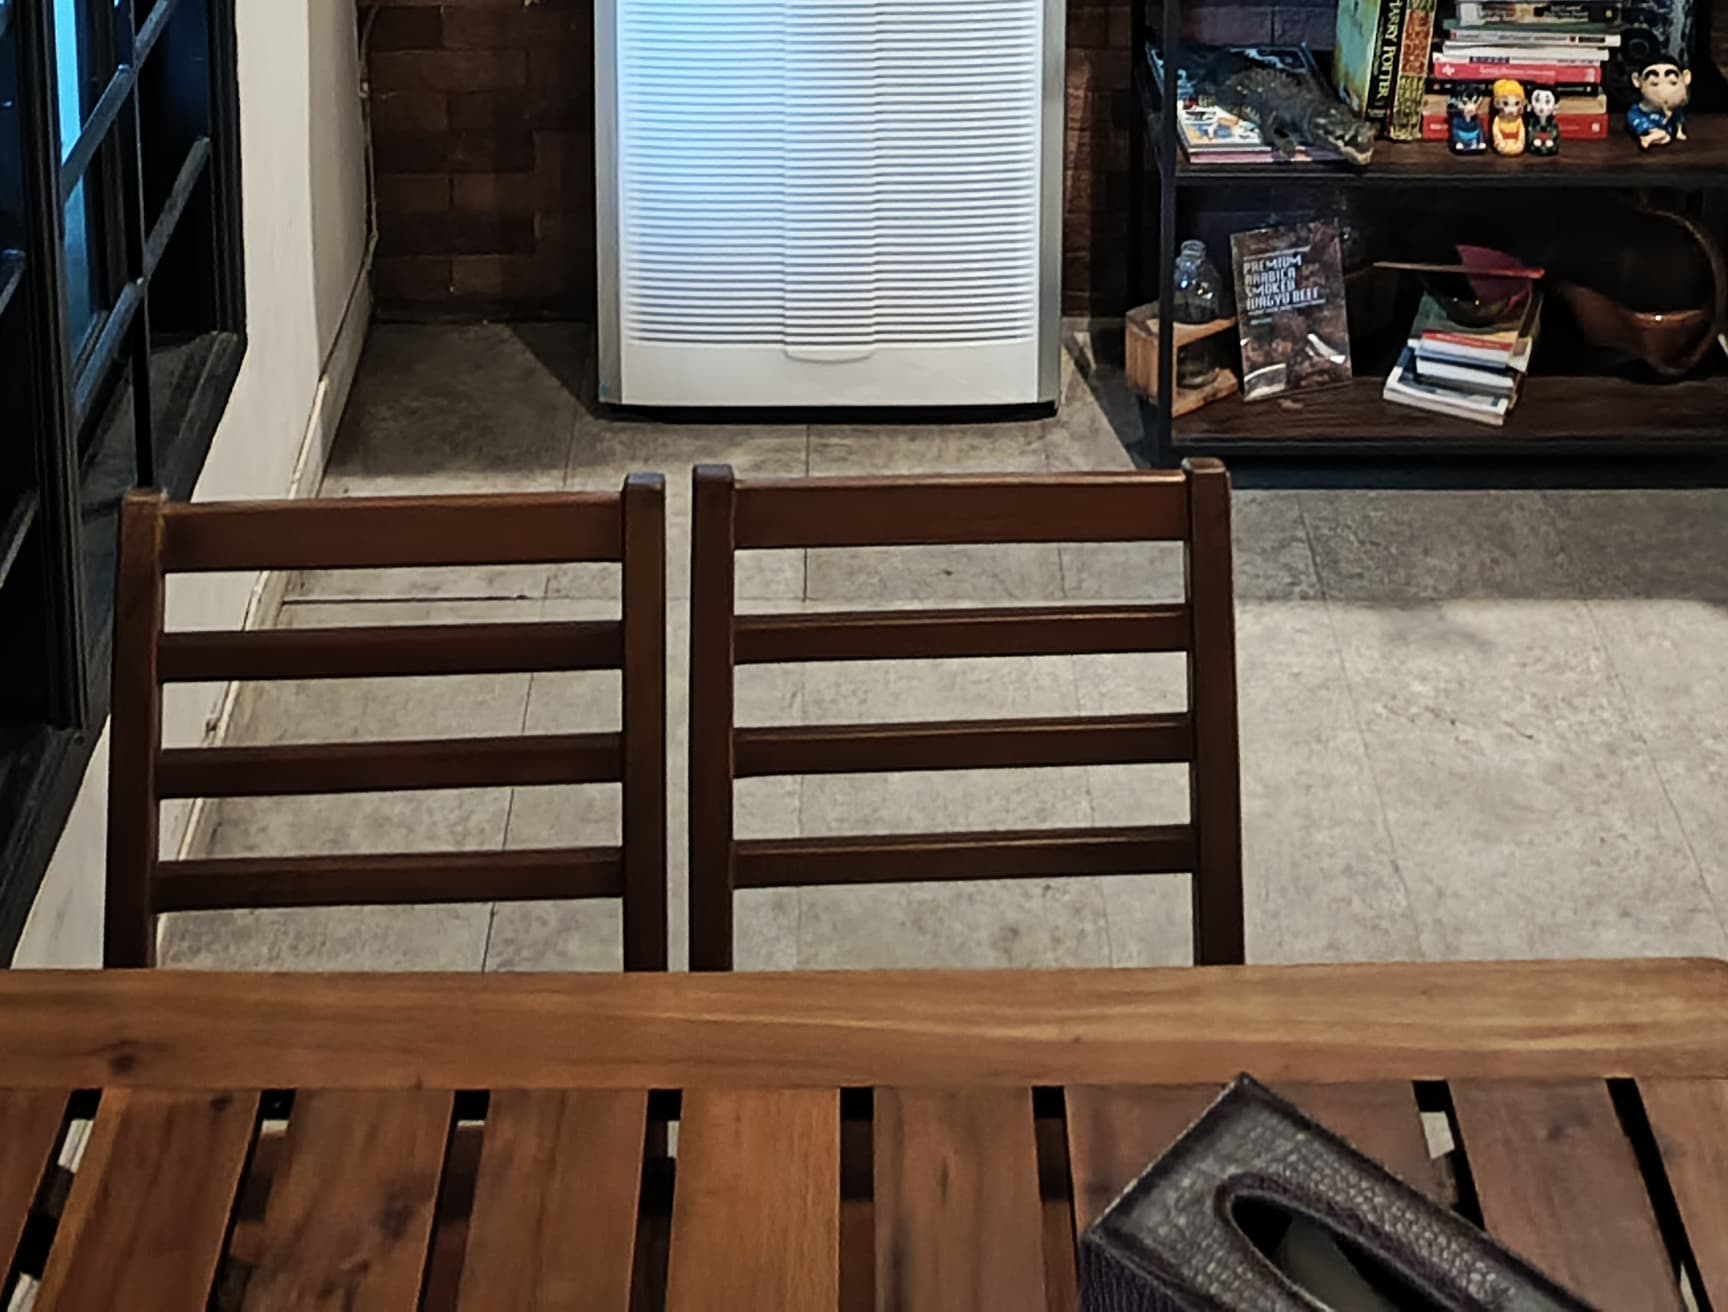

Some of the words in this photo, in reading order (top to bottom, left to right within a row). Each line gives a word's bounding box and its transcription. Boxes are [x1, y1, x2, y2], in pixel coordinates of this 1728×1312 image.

[1376, 45, 1397, 98] POTTER
[1243, 254, 1302, 275] PREMIUM
[1245, 266, 1296, 286] ARABICA
[1245, 279, 1296, 298] SMOKED
[1246, 292, 1290, 311] WAGYU
[1293, 287, 1319, 303] BEEF
